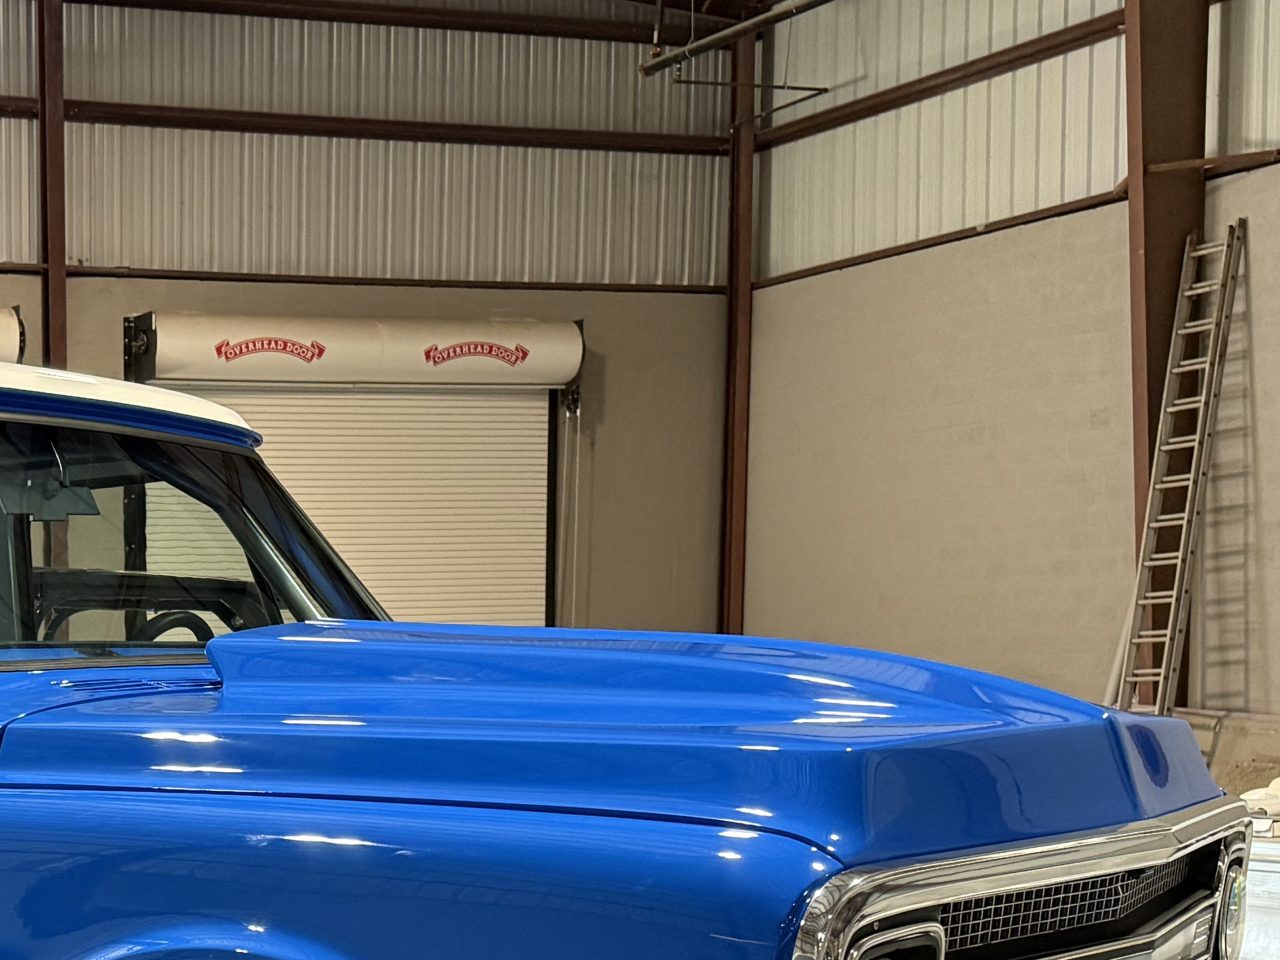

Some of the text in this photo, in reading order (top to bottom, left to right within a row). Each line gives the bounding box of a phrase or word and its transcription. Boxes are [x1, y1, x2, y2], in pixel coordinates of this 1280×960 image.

[227, 340, 313, 360] OVERHEAD DOOR
[435, 344, 517, 363] OVERHEAD DOOR
